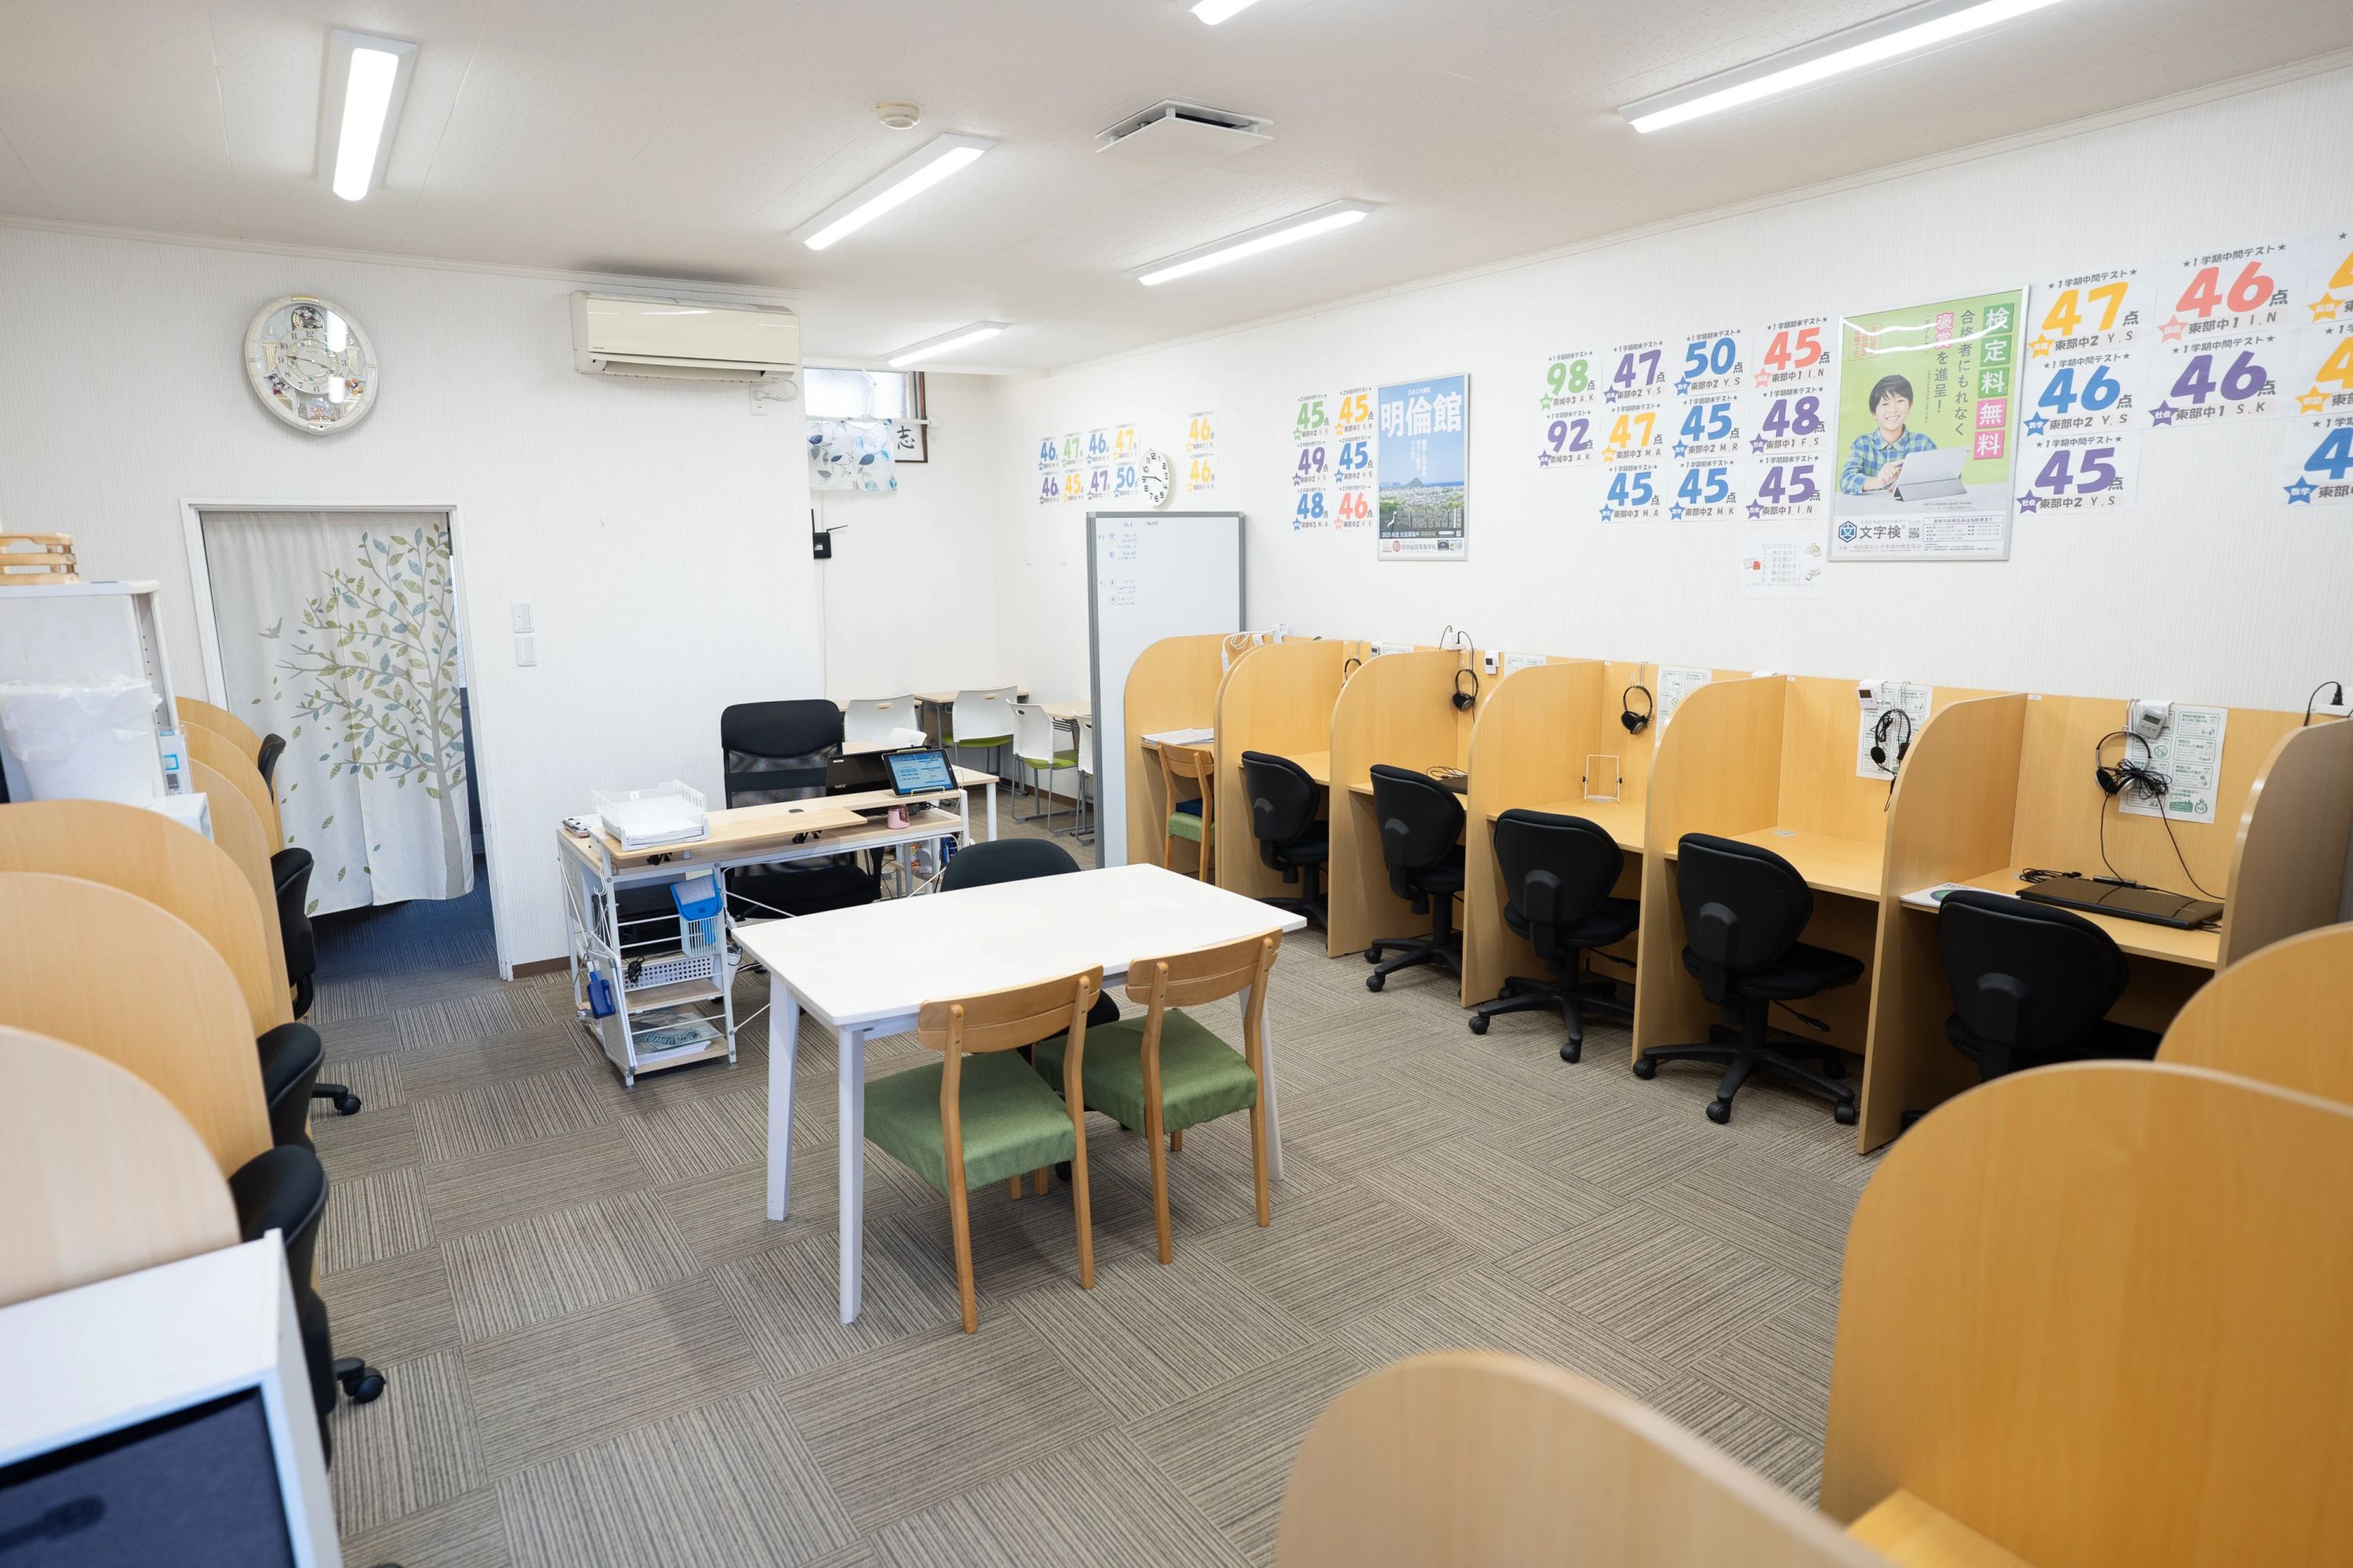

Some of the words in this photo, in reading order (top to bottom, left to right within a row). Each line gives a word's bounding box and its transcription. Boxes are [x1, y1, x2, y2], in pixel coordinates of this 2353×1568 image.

[2194, 246, 2275, 267] 1学期中間テスト
[2058, 270, 2127, 288] 1学期中間テスト
[2176, 261, 2275, 318] 46
[2269, 289, 2288, 307] 点
[2042, 282, 2129, 337] 47
[2122, 311, 2139, 326] 点
[2188, 317, 2239, 334] 東部中1
[1764, 327, 1821, 370] 45
[2055, 336, 2099, 351] 東部中2
[2184, 337, 2264, 353] 1学期中間テスト
[1613, 349, 1661, 388] 47
[1684, 337, 1736, 379] 50
[2053, 354, 2121, 369] 1学期中間テスト
[1547, 359, 1588, 395] 98
[1955, 310, 1975, 435] 合格者にもれなく
[1977, 307, 2009, 457] 検定料無料
[2170, 351, 2267, 405] 46
[2038, 365, 2121, 414] 46
[2117, 395, 2133, 409] 点
[1297, 401, 1324, 429] 45
[1340, 394, 1369, 424] 45
[1381, 391, 1462, 438] 明倫館
[1680, 403, 1732, 442] 45
[1762, 396, 1820, 437] 48
[2176, 406, 2225, 420] 東部中1
[897, 425, 915, 449] 志
[1189, 418, 1211, 442] 46
[1547, 419, 1589, 453] 92
[1609, 412, 1656, 449] 47
[2049, 417, 2093, 430] 東部中2
[1041, 442, 1056, 461] 46
[1064, 438, 1080, 459] 47
[1089, 433, 1106, 454] 46
[1116, 429, 1133, 452] 47
[2046, 436, 2113, 447] 1学期中間テスト
[1298, 447, 1325, 475] 49
[1339, 441, 1368, 470] 45
[1065, 474, 1081, 494] 45
[1091, 470, 1107, 492] 47
[1117, 466, 1135, 488] 50
[1190, 460, 1212, 483] 46
[1758, 464, 1815, 504] 45
[2035, 447, 2115, 495] 45
[1042, 477, 1057, 497] 46
[1607, 471, 1653, 506] 45
[1678, 467, 1729, 504] 45
[1297, 492, 1324, 519] 48
[1339, 492, 1368, 519] 46
[2040, 497, 2082, 508] 東部中2
[1860, 525, 1901, 539] 文字検
